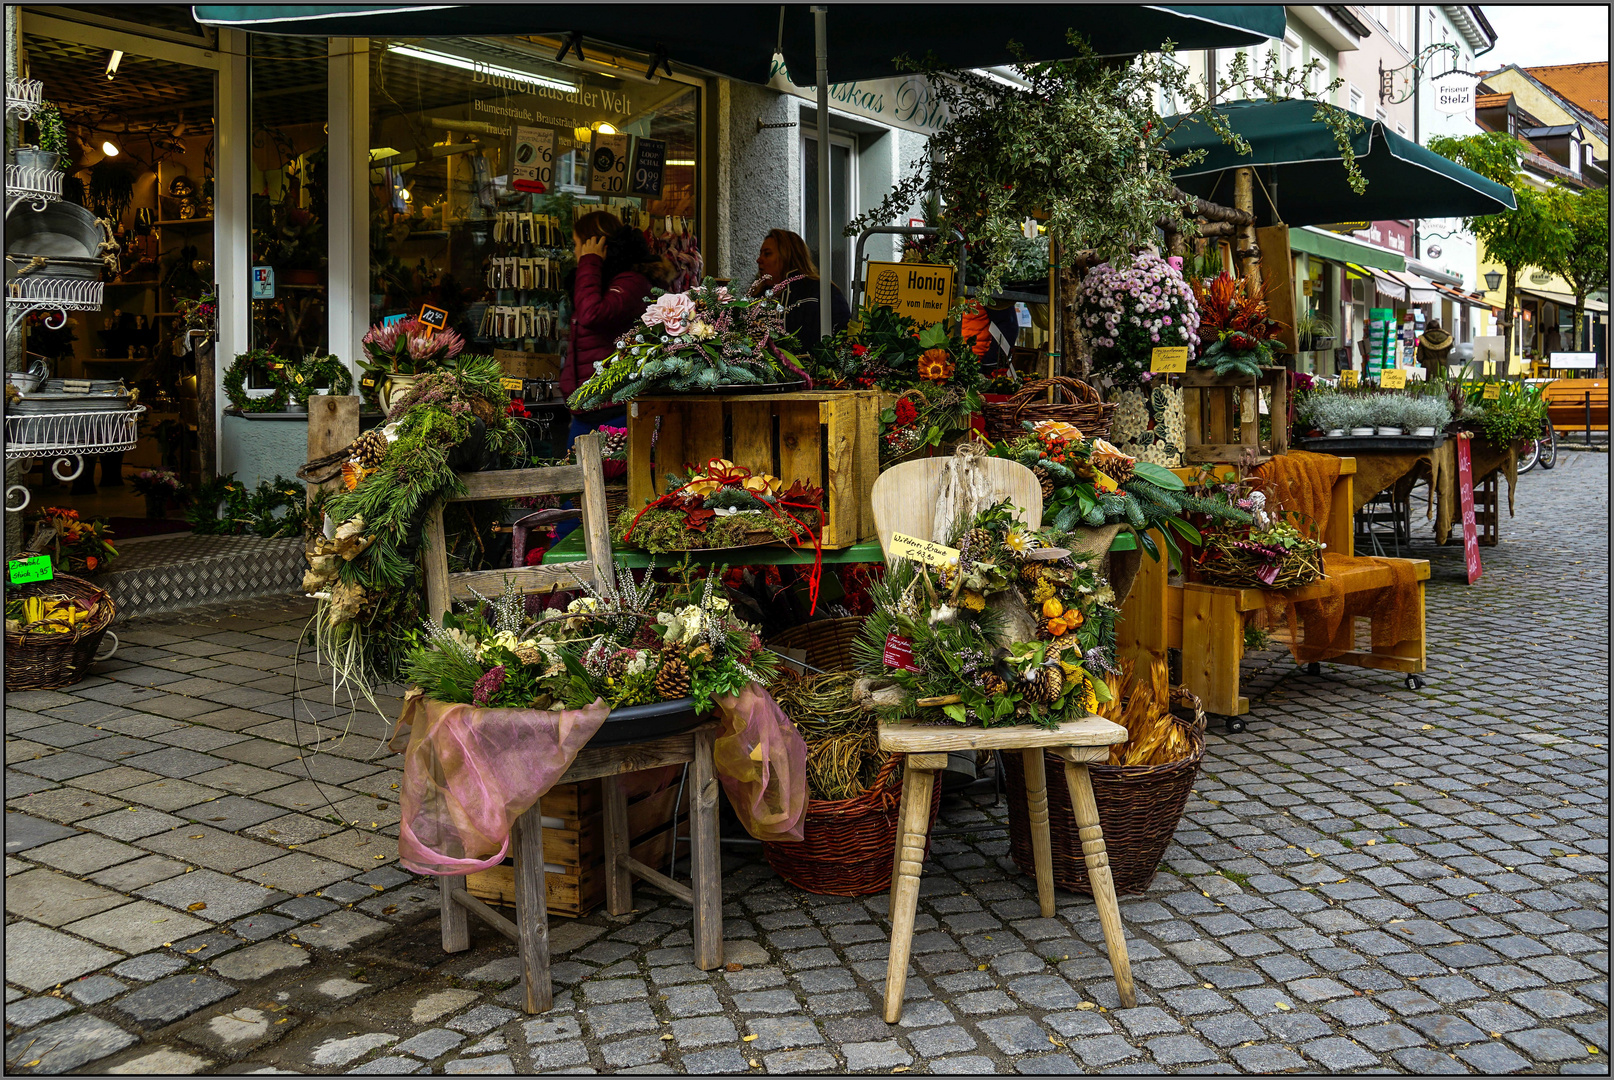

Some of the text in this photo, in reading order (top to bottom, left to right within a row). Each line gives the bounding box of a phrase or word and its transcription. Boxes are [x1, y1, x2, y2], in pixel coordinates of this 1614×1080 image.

[472, 59, 632, 116] Blumen aus aller Welt
[1440, 86, 1469, 94] Friseur
[1440, 93, 1469, 105] Stelzl
[474, 99, 534, 122] Blumensträuße,
[639, 158, 660, 167] SCHAL
[908, 271, 945, 296] Honig
[922, 299, 943, 310] Imker
